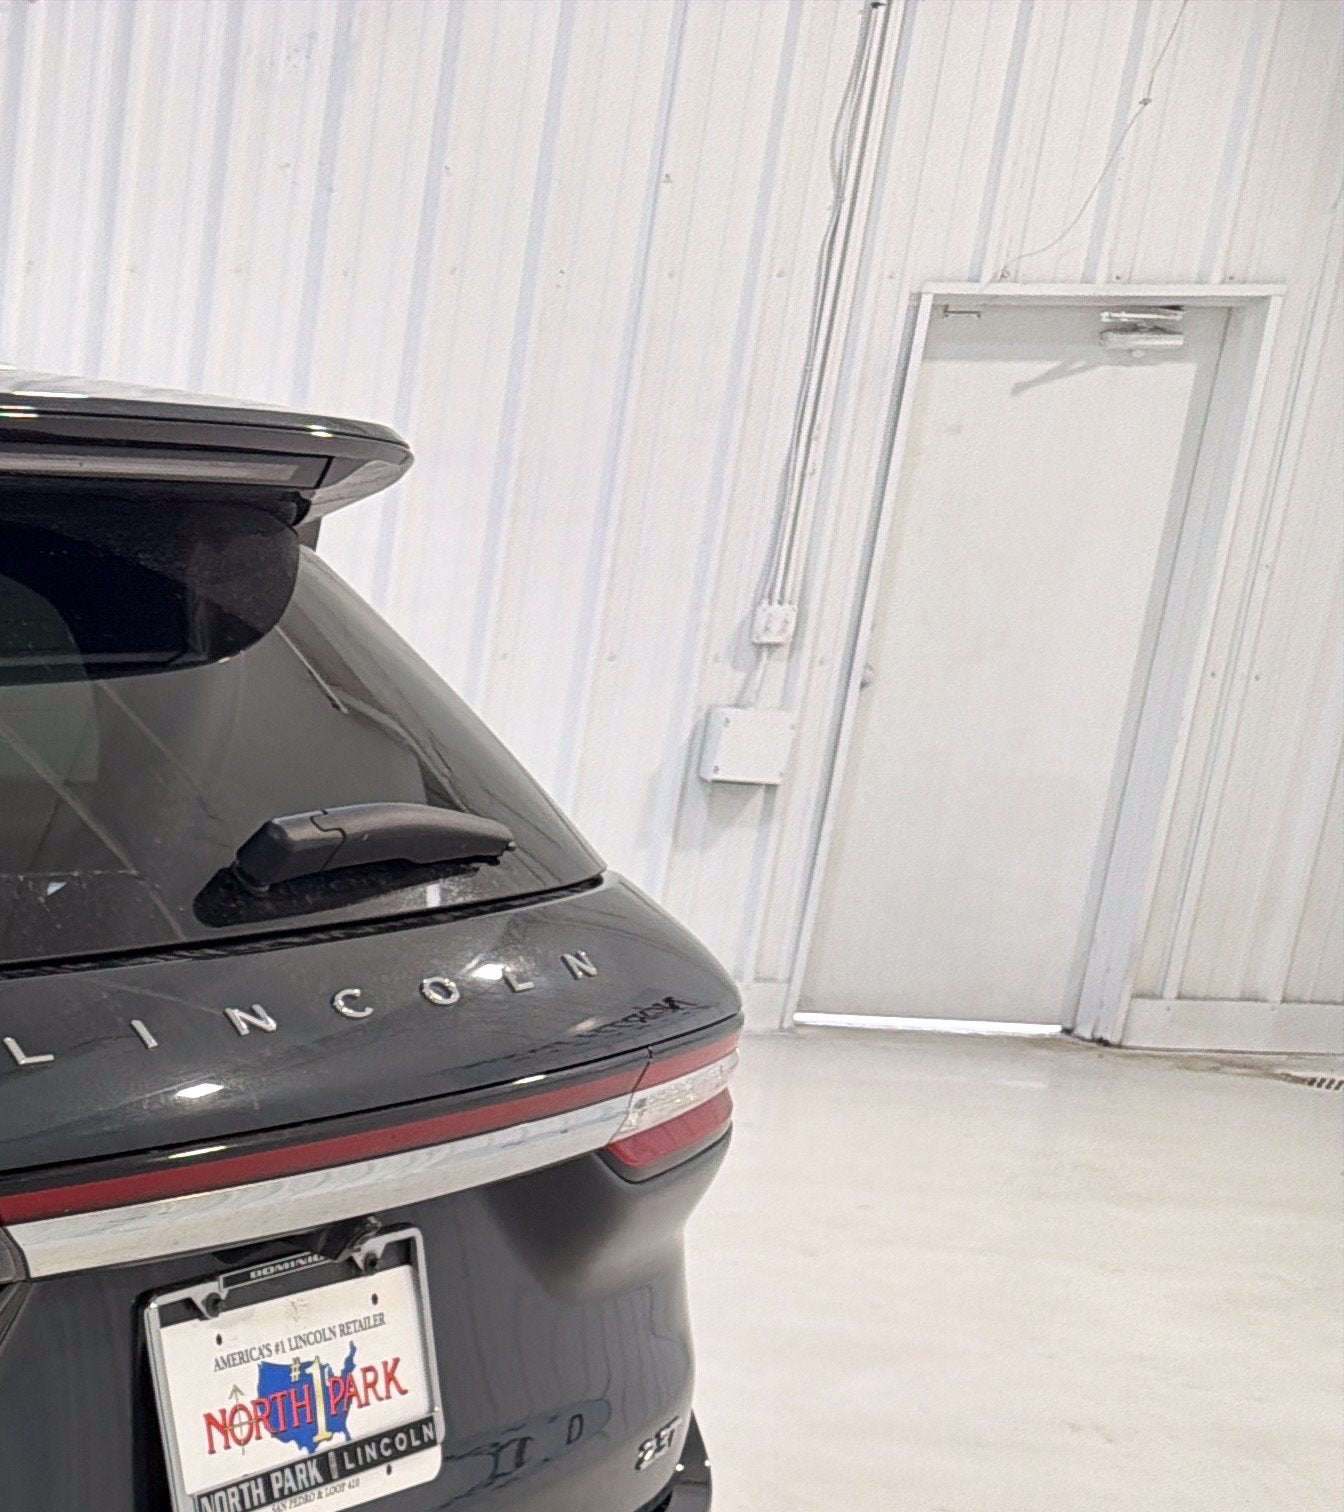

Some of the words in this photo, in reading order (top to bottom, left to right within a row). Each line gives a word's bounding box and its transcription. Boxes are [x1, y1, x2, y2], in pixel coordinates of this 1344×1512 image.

[2, 949, 598, 1066] LINCOLN
[249, 1253, 325, 1279] DOMINI
[213, 1342, 273, 1373] AMERICA'S
[274, 1340, 286, 1355] #1
[288, 1326, 337, 1352] LINCOLN
[339, 1312, 386, 1337] RETAILER
[203, 1384, 313, 1454] NORTH
[328, 1357, 408, 1417] PARK
[271, 1458, 324, 1500] PARK
[343, 1420, 435, 1470] LINCOLN
